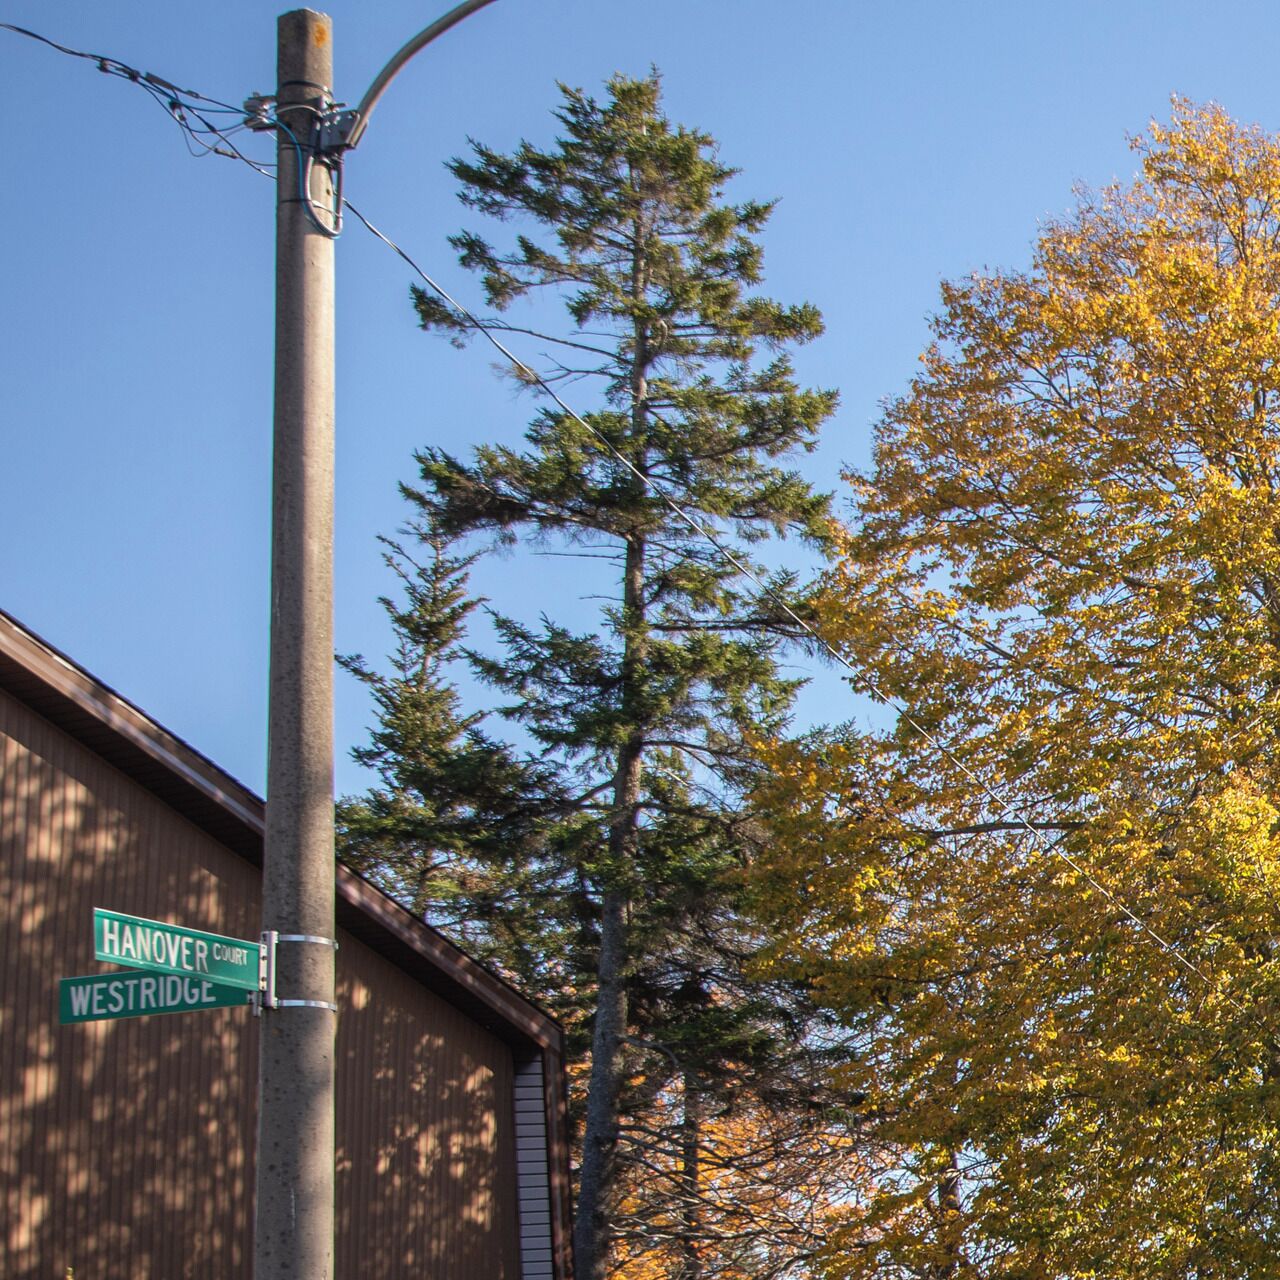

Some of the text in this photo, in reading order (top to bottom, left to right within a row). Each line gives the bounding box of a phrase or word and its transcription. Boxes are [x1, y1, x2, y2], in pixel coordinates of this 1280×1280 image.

[103, 919, 248, 973] HANOVER COURT
[71, 976, 216, 1017] WESTRIDGE
